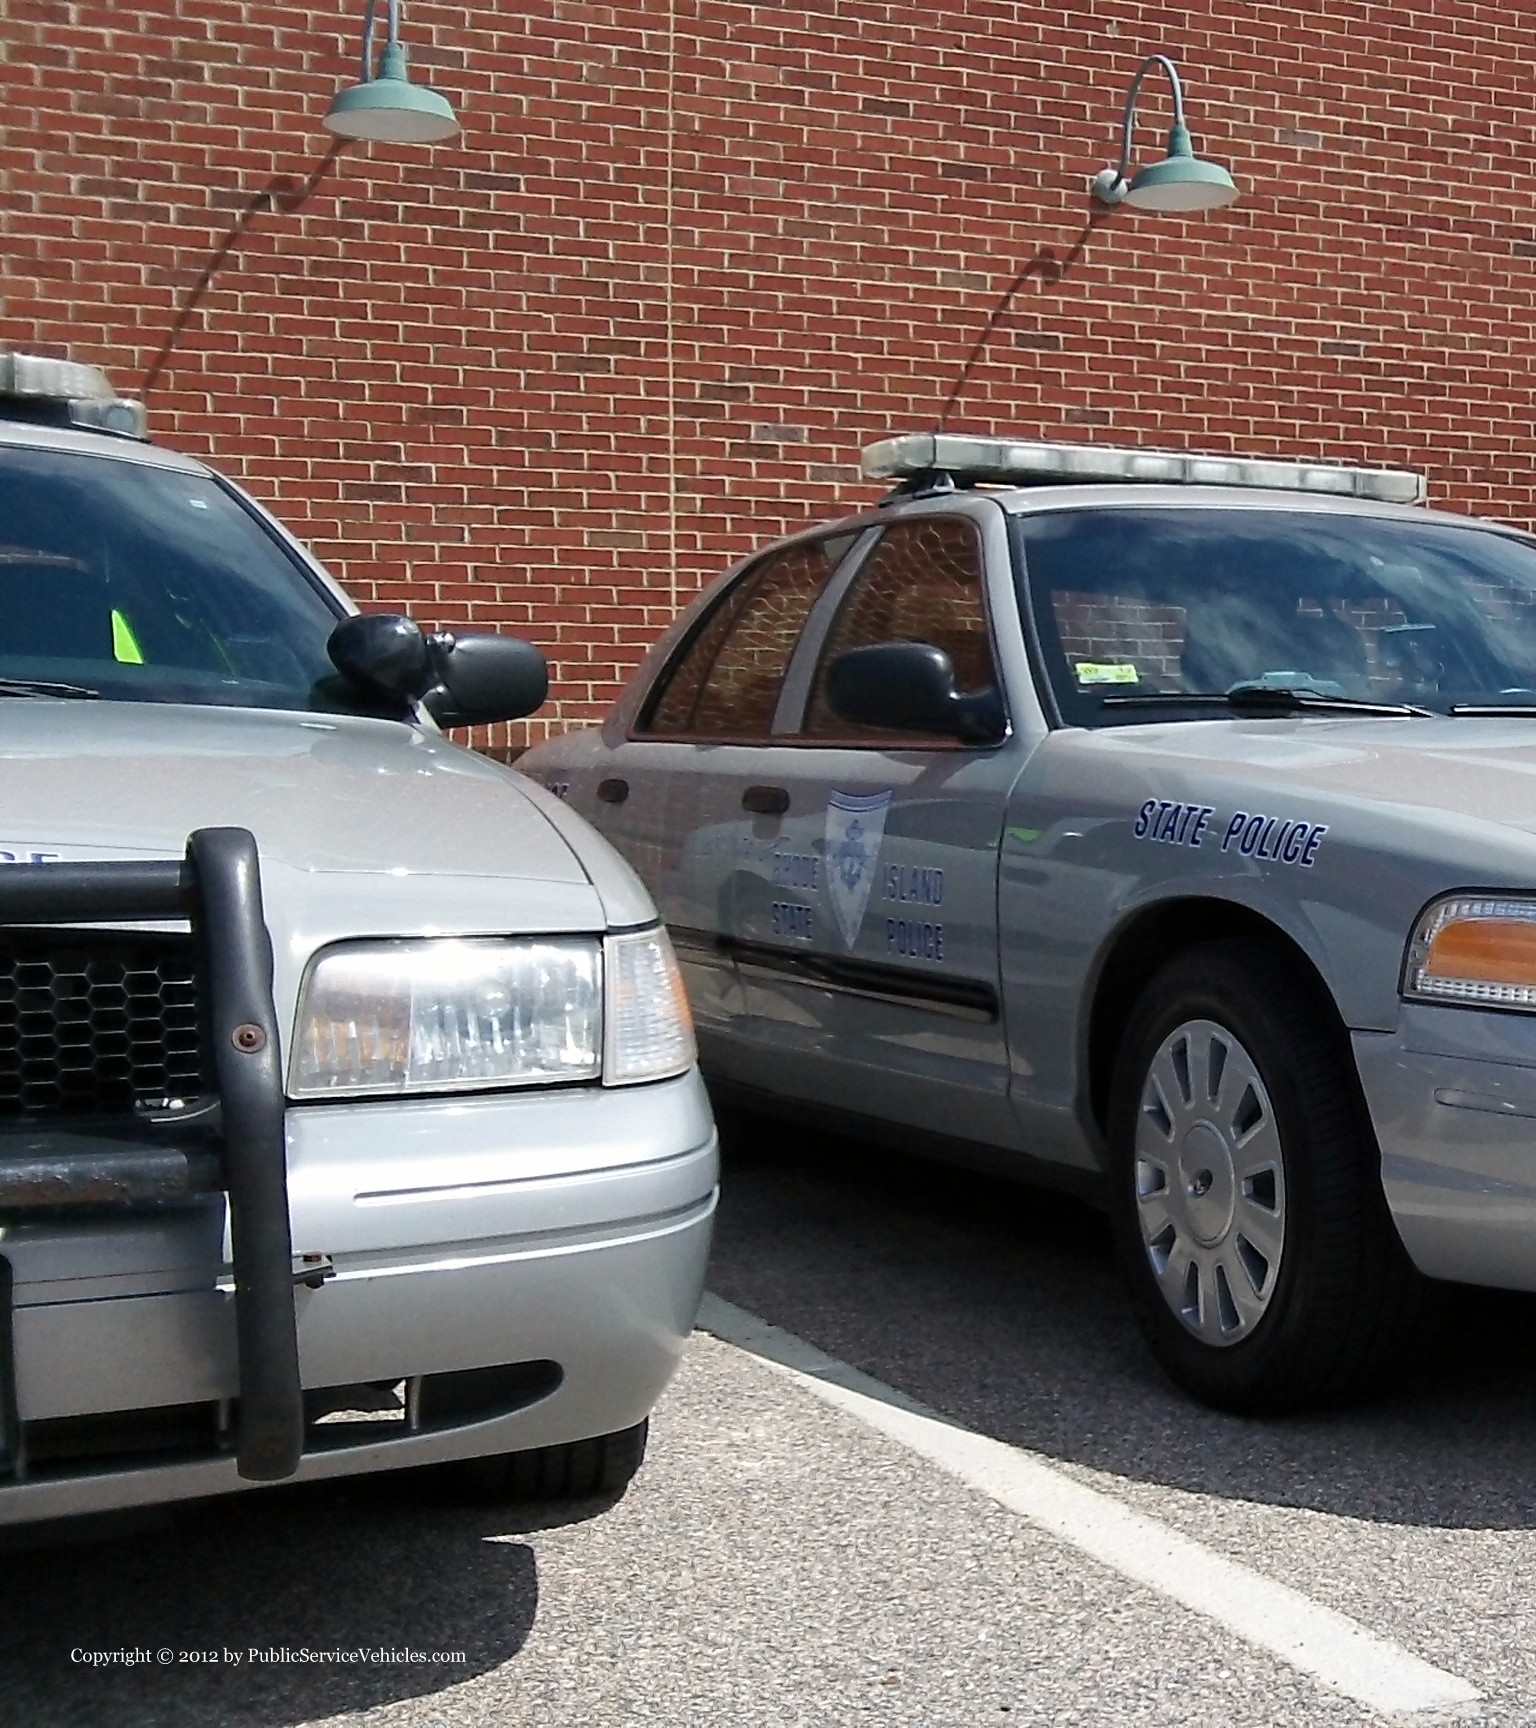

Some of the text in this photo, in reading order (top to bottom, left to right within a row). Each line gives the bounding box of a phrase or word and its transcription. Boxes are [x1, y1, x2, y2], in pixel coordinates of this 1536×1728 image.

[1134, 798, 1329, 868] STATE POLICE
[772, 851, 944, 906] RHODE ISLAND
[771, 901, 944, 963] STATE POLICE
